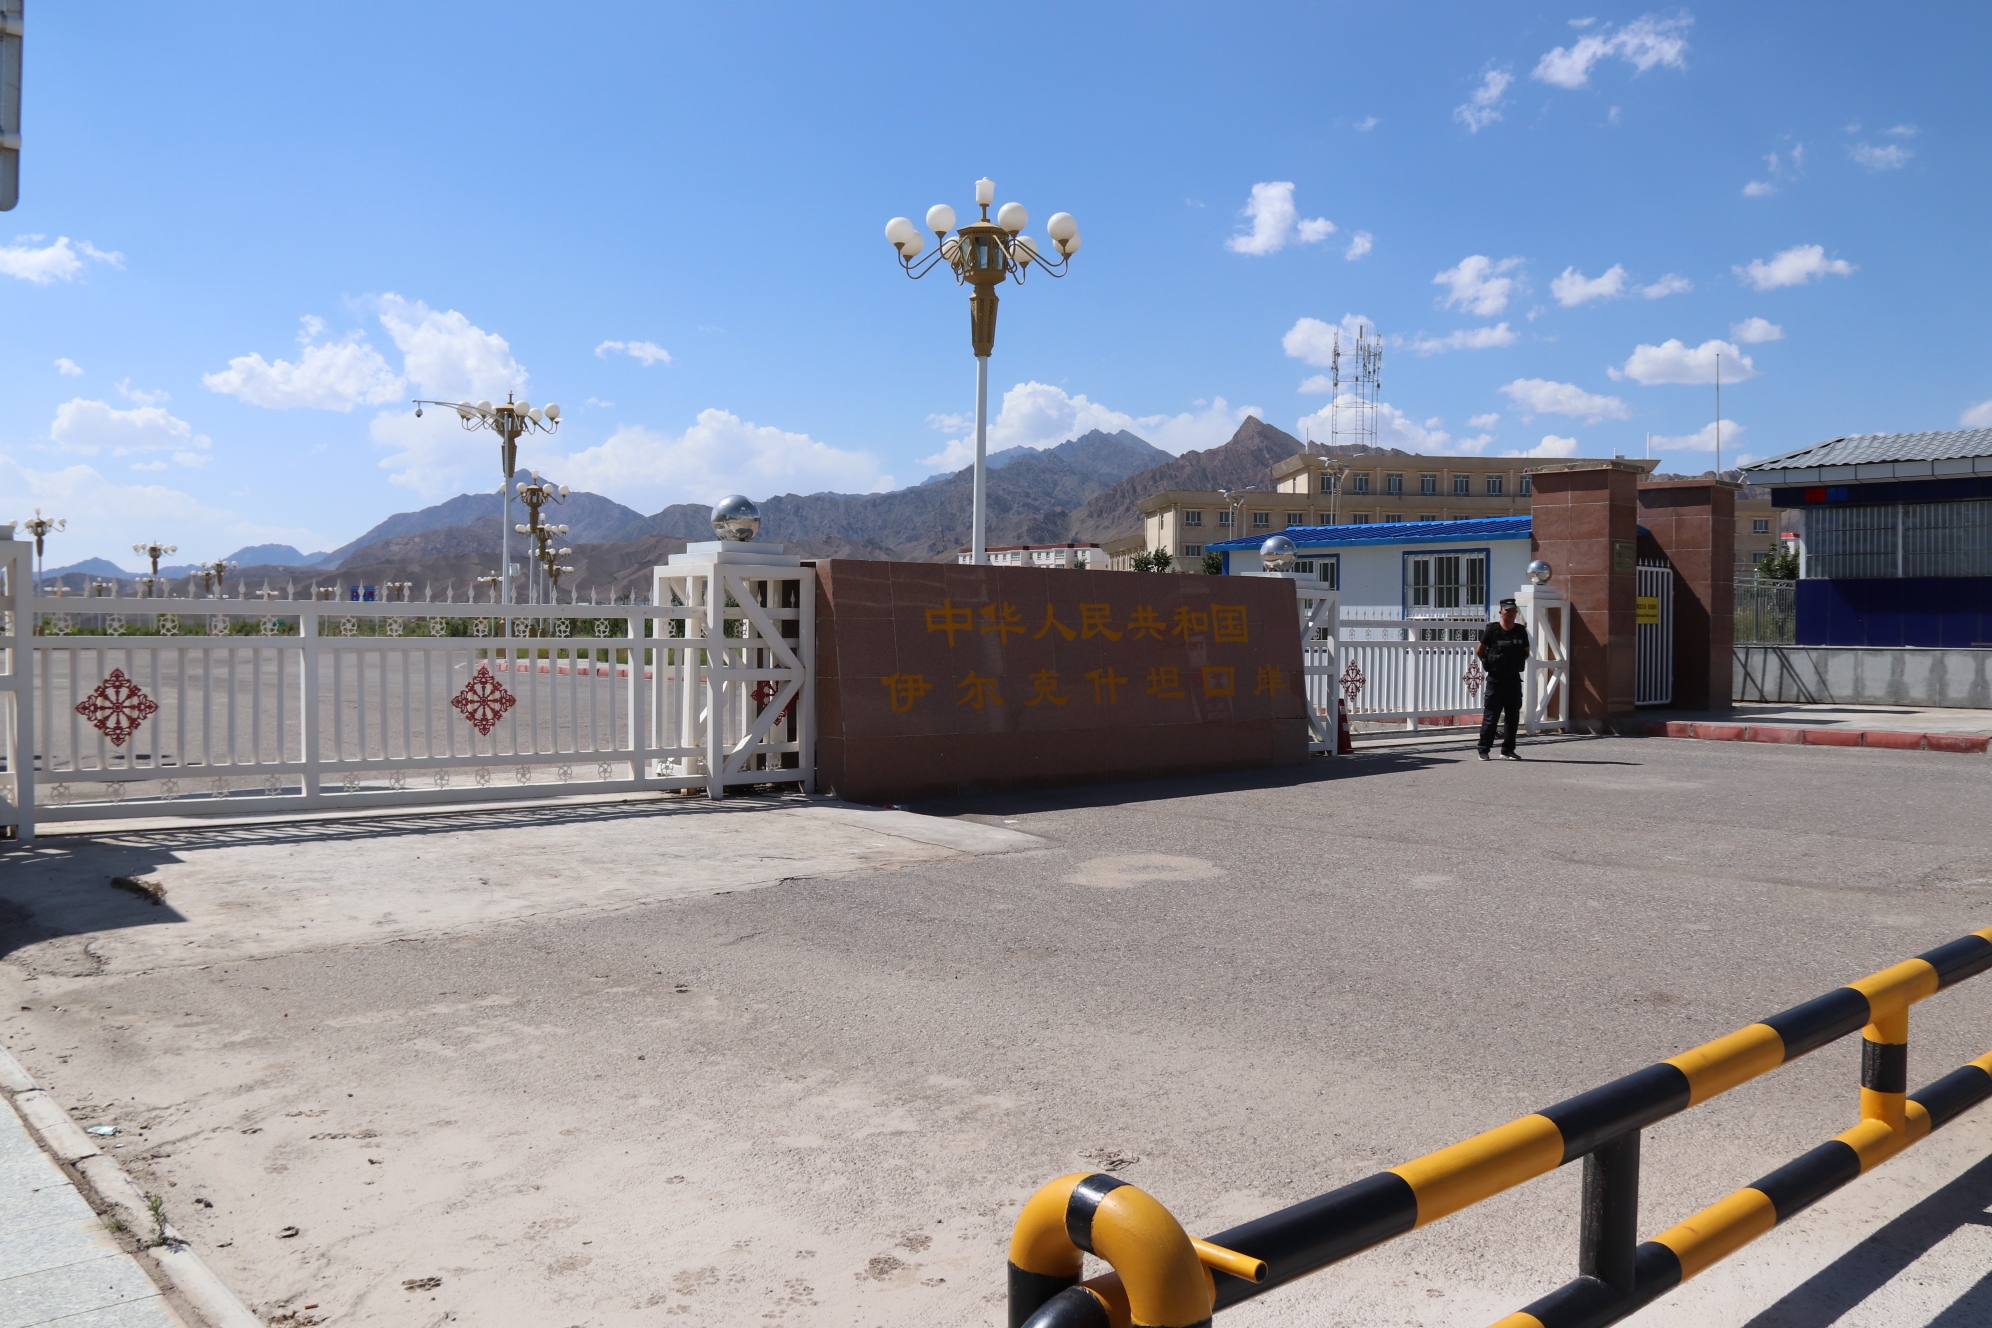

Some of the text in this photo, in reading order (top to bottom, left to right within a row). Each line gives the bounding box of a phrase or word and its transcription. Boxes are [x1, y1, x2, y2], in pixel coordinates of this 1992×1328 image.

[925, 598, 1250, 648] 中华人民共和国
[881, 663, 1287, 713] 伊尔克什坦口岸
